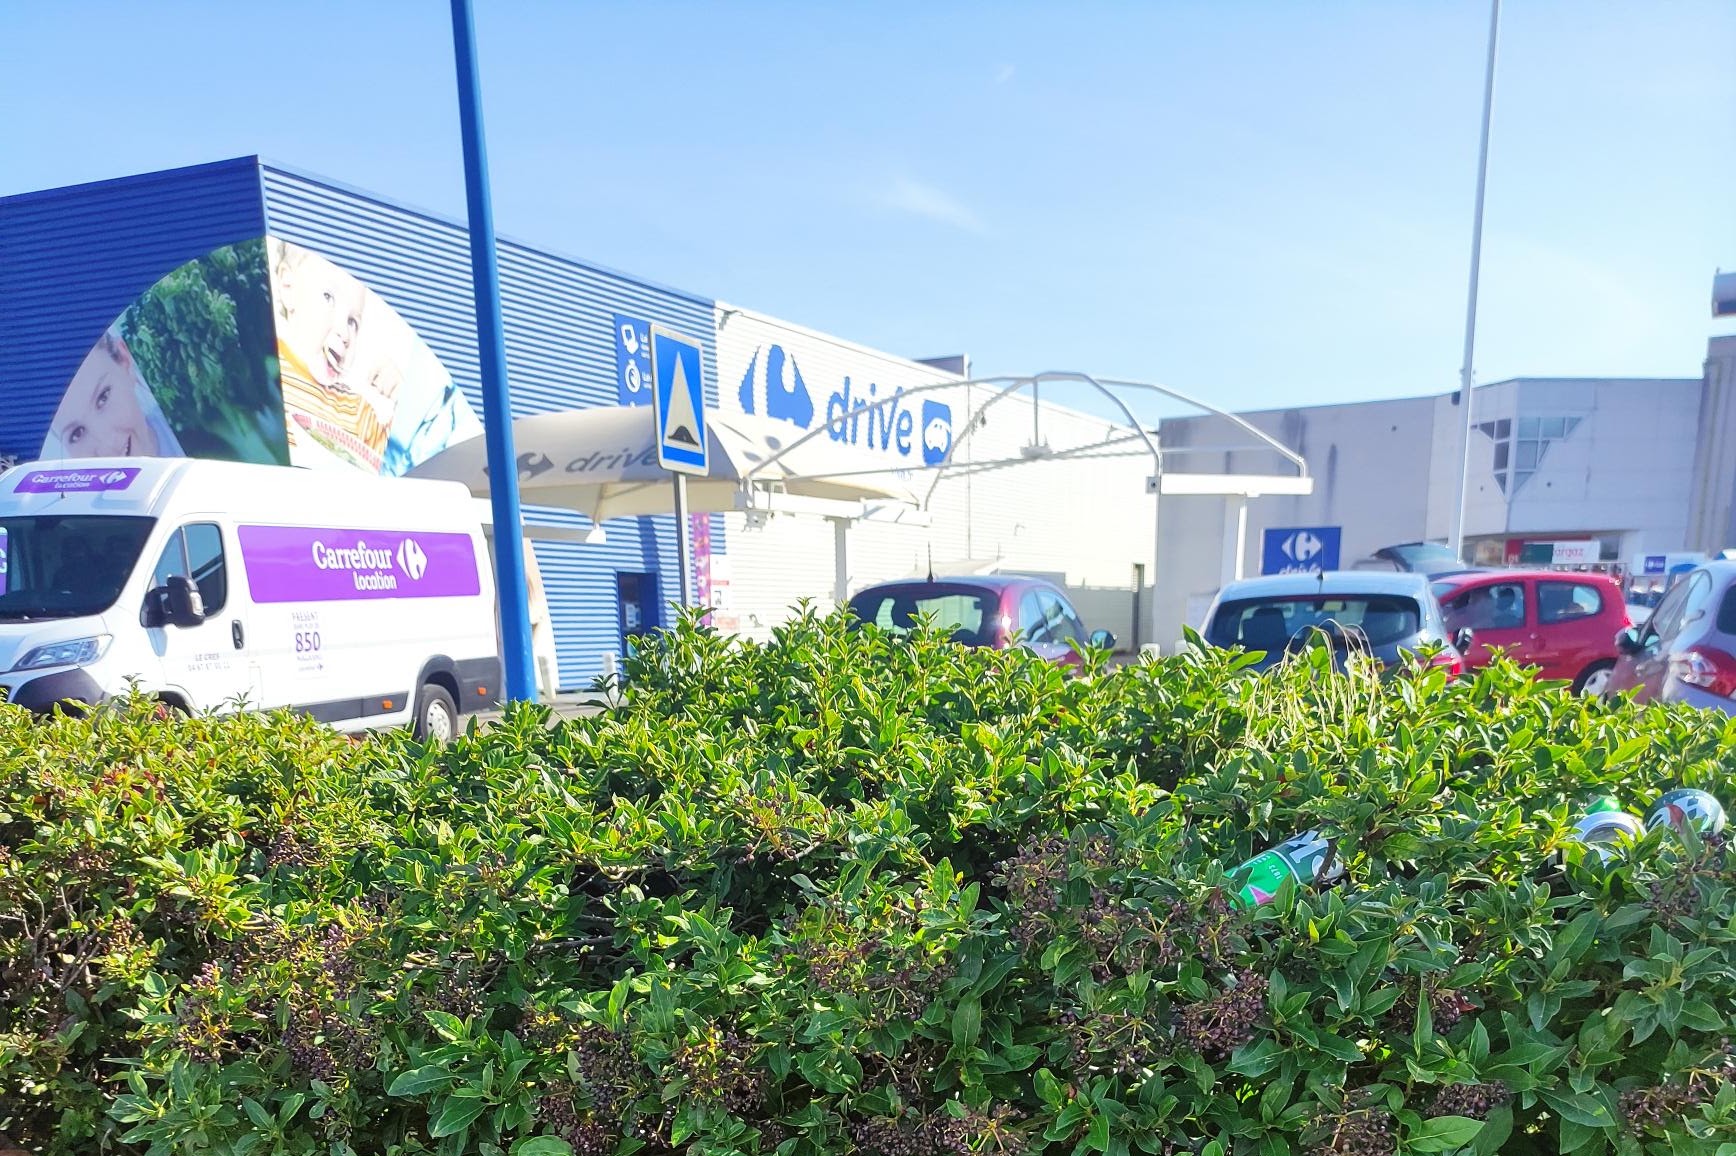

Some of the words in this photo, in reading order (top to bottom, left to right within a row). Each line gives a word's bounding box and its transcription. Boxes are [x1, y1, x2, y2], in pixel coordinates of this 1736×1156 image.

[827, 376, 913, 457] drive
[564, 448, 659, 473] drive
[32, 472, 97, 484] Carrefour
[312, 540, 393, 569] Carrefour
[352, 570, 398, 591] location
[295, 631, 321, 652] 850
